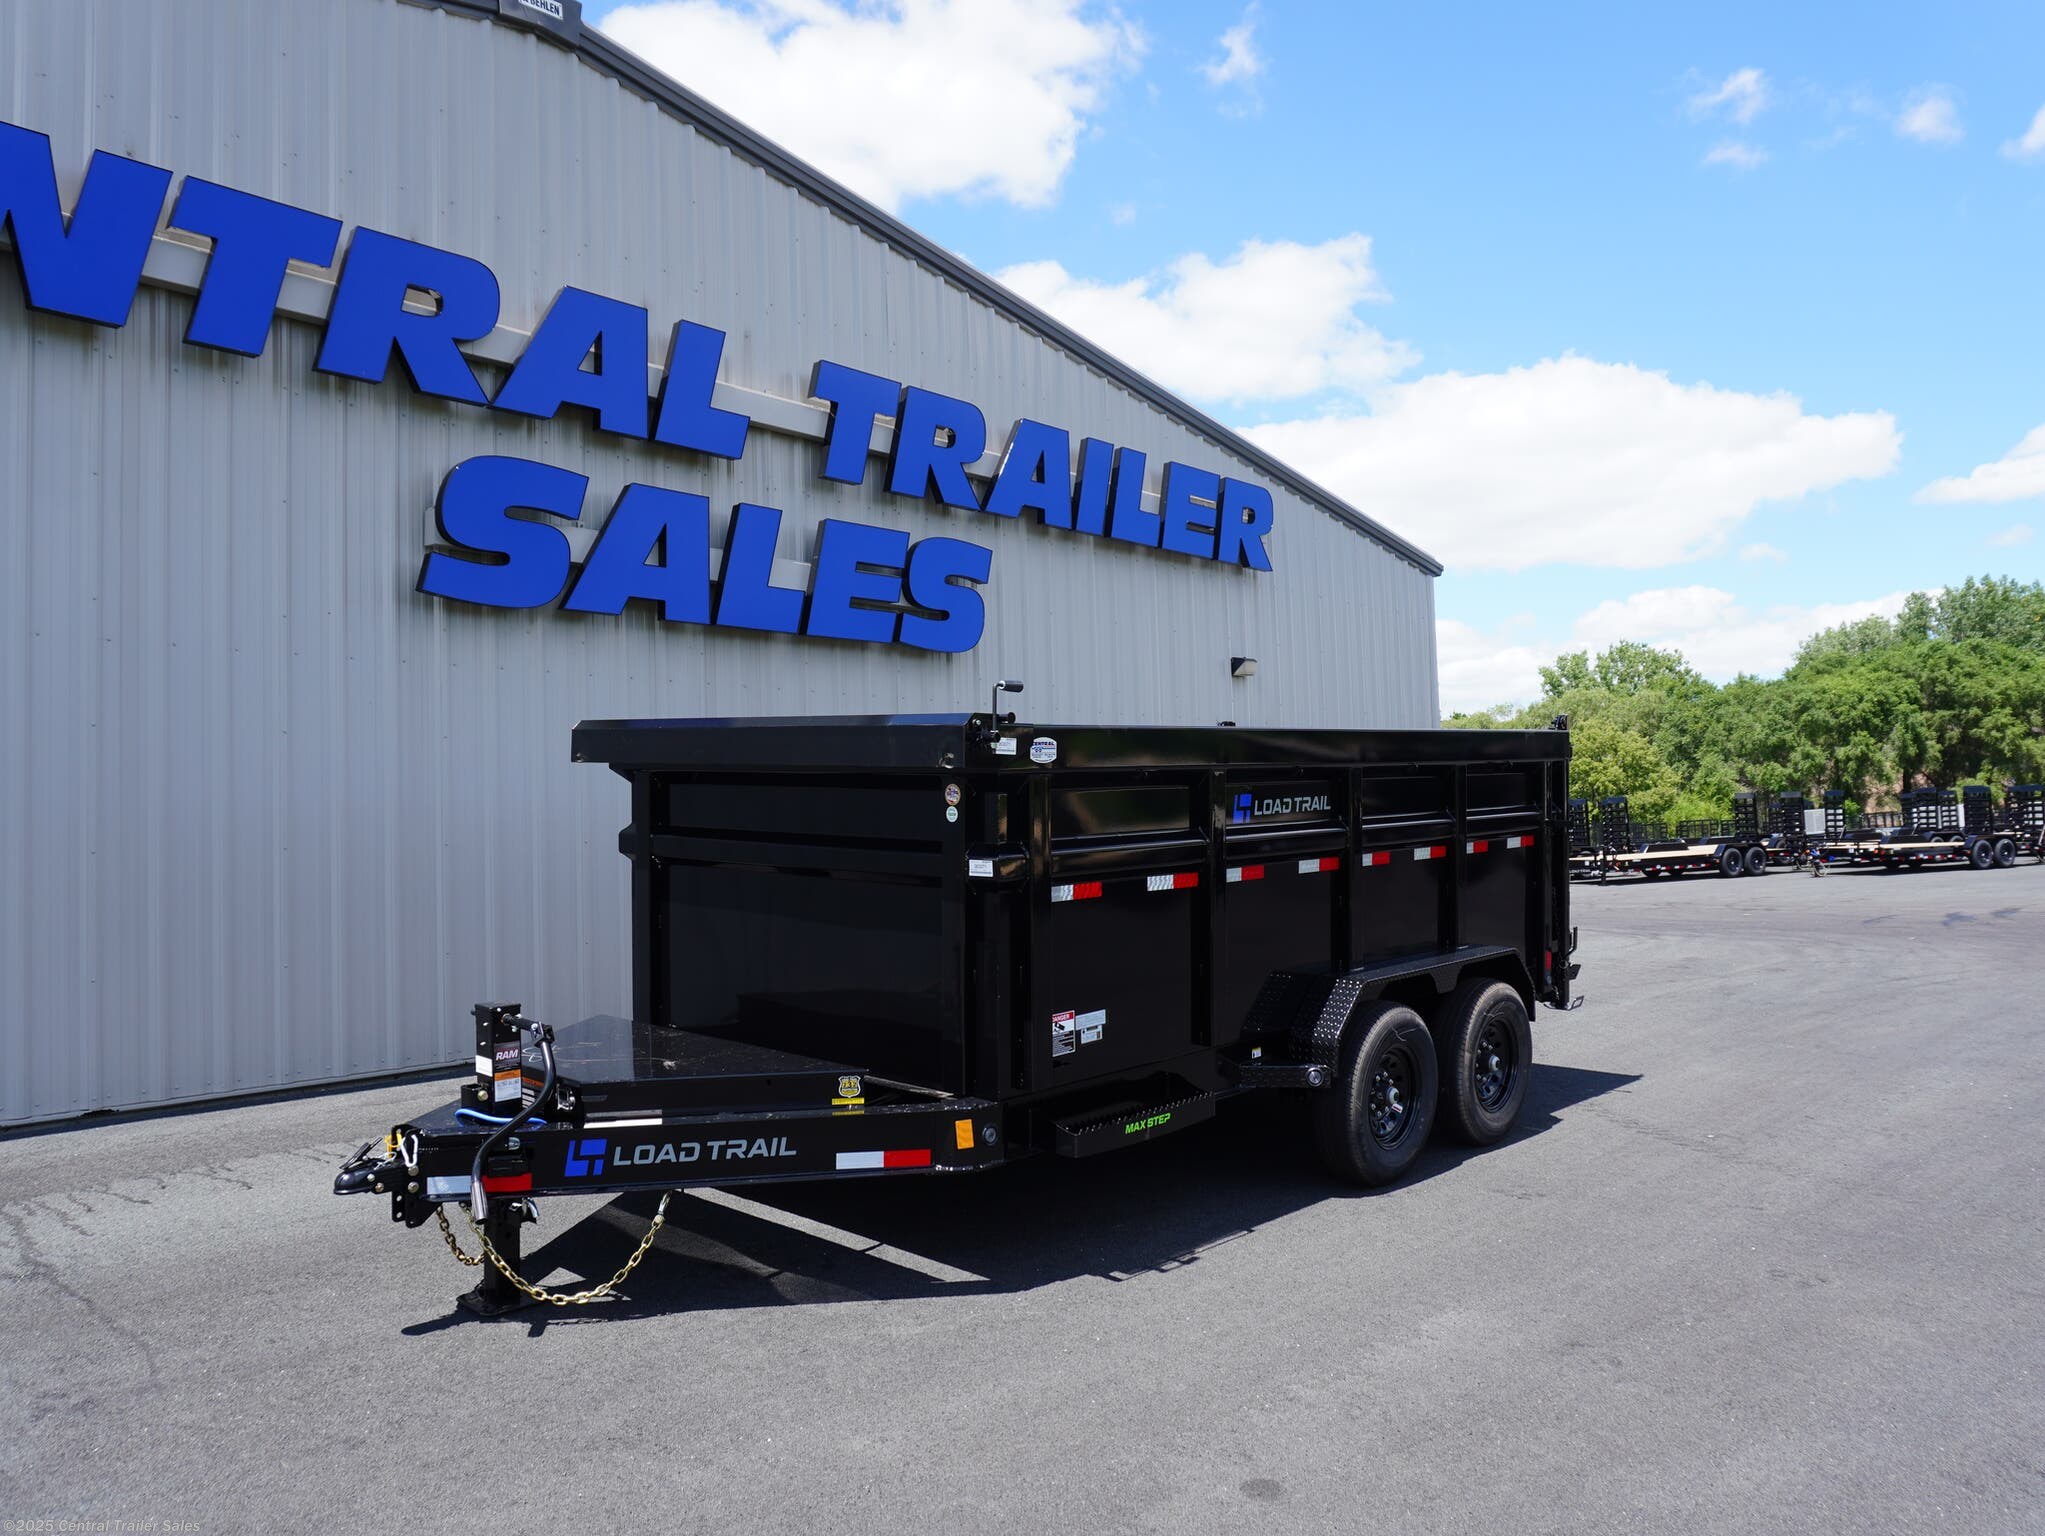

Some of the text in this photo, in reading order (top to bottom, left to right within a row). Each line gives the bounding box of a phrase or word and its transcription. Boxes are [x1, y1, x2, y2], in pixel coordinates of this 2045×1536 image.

[810, 359, 1275, 572] TRAILER
[417, 455, 994, 654] SALES
[1254, 798, 1292, 816] LOAD
[1294, 795, 1332, 812] TRAIL
[495, 1049, 519, 1061] RAM
[1125, 1112, 1171, 1135] MAX STEP
[613, 1143, 701, 1167] LOAD
[706, 1136, 798, 1161] TRAIL
